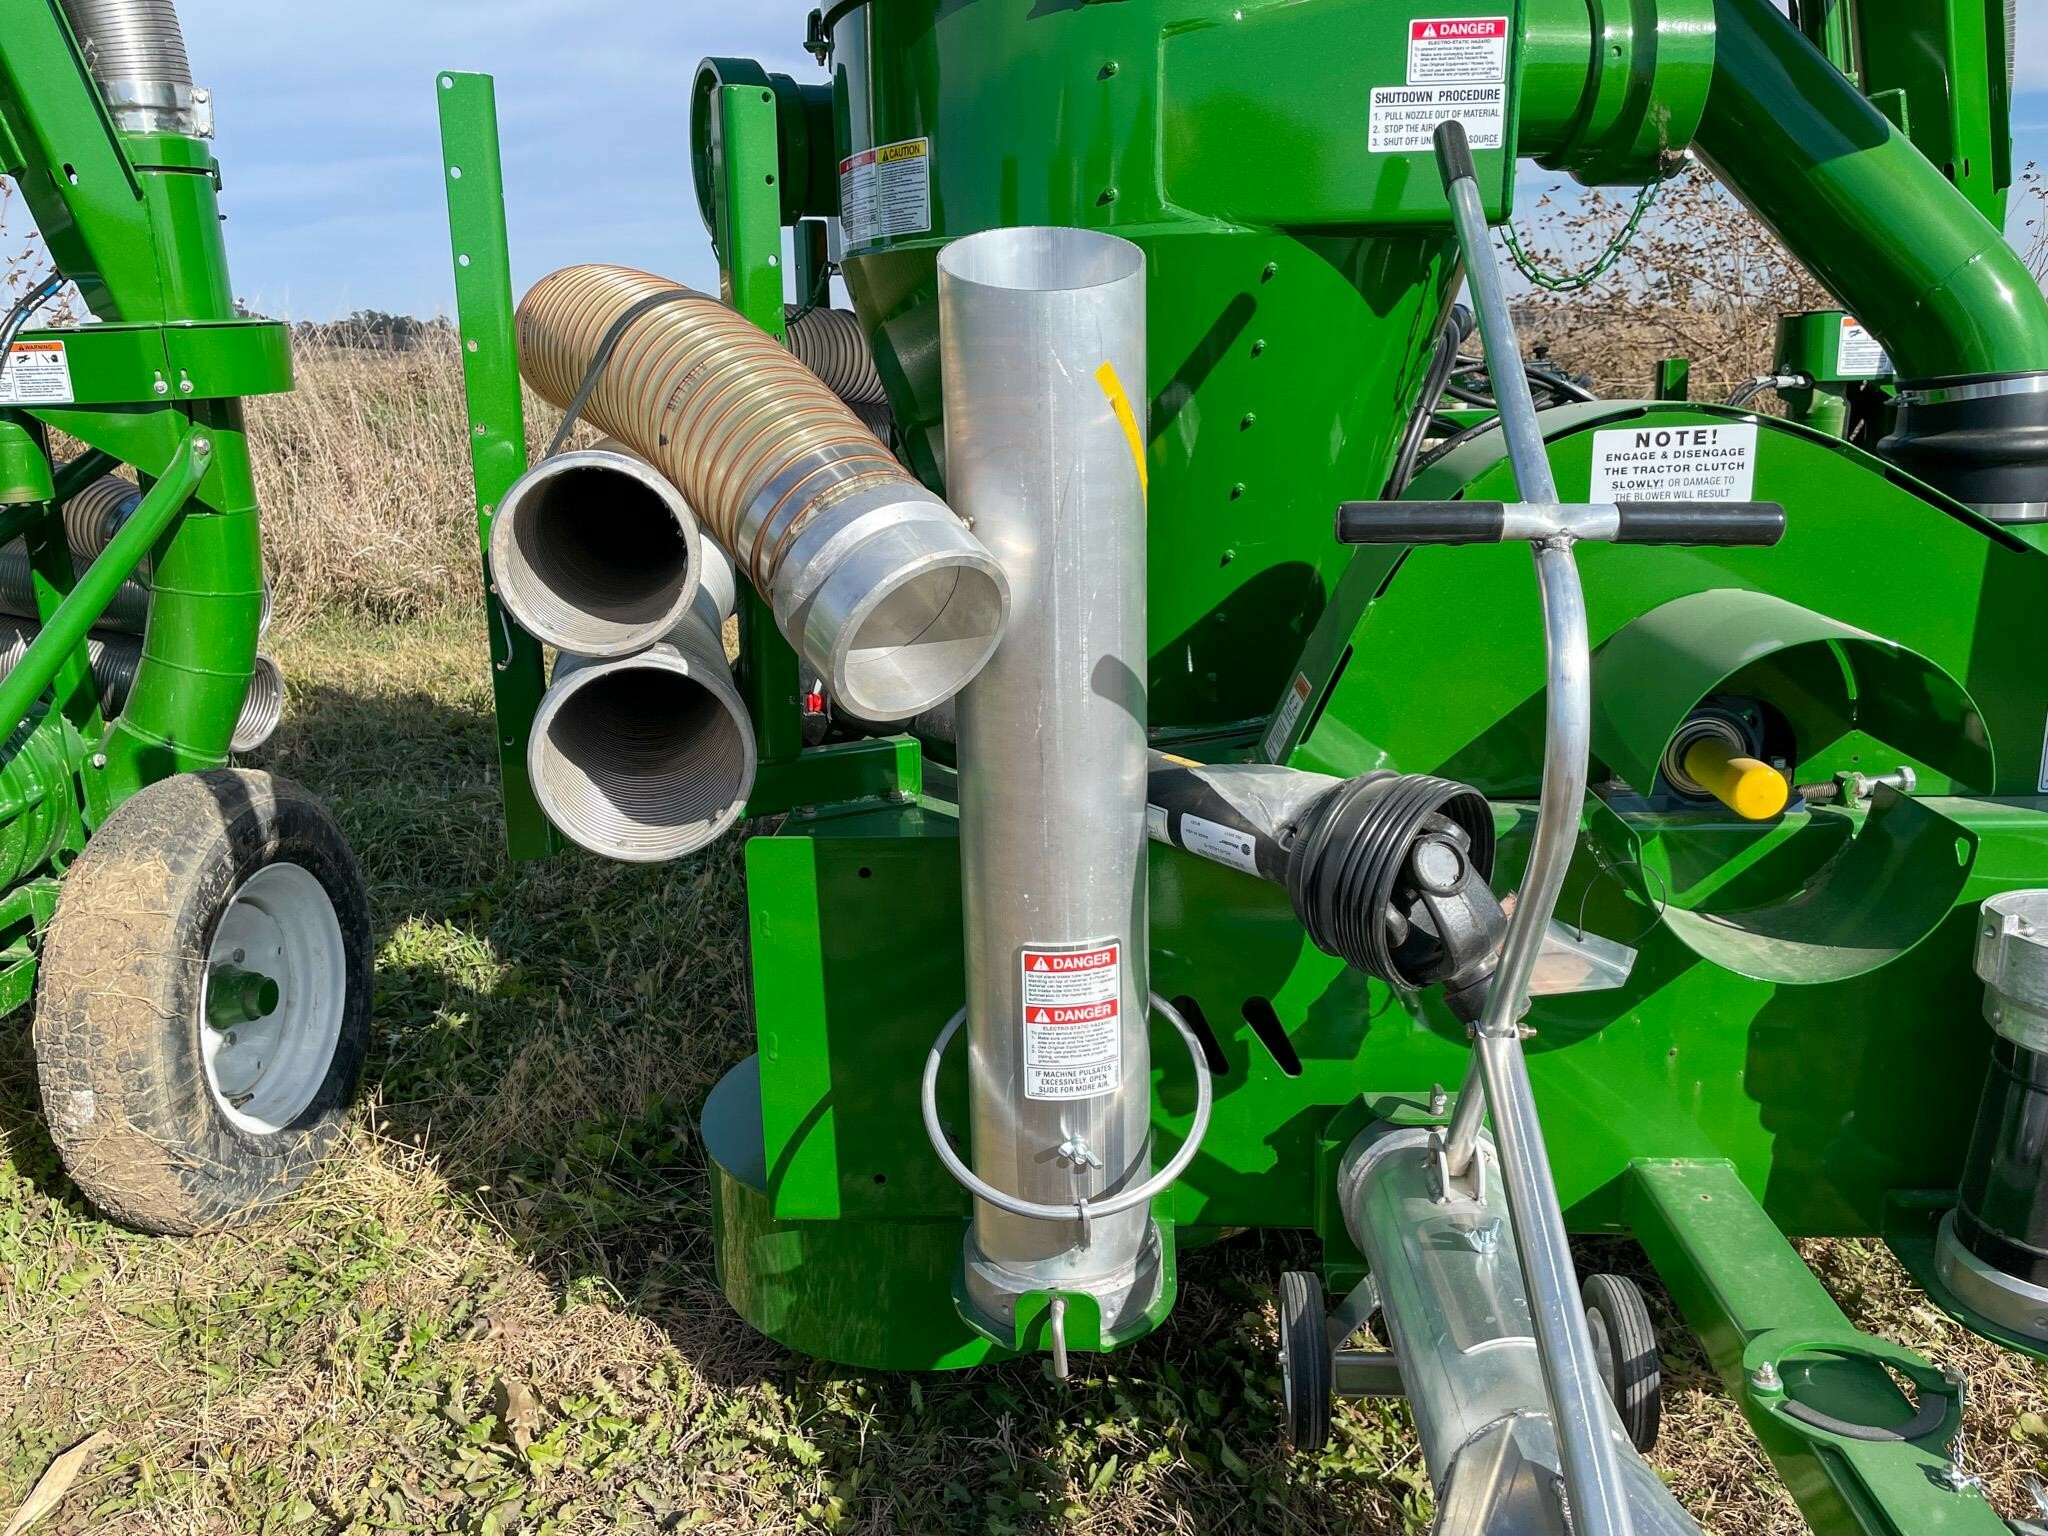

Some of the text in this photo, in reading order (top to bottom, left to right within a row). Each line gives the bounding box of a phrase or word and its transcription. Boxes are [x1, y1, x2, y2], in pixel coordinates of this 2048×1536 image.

[1440, 23, 1496, 35] DANGER
[1375, 89, 1500, 104] SHUTDOWN PROCEDURE
[1385, 112, 1403, 120] PULL
[1405, 111, 1433, 119] NOZZLE
[1435, 110, 1450, 119] OUT
[1452, 110, 1461, 118] OF
[1463, 109, 1500, 117] MATERIAL
[1384, 125, 1403, 133] STOP
[1405, 124, 1418, 132] THE
[1372, 138, 1379, 146] 3.
[1383, 137, 1403, 146] SHUT
[1405, 137, 1418, 145] OFF
[1468, 134, 1498, 143] SOURCE
[889, 145, 920, 158] CAUTION
[1635, 429, 1718, 448] NOTE!
[1606, 448, 1745, 462] ENGAGE & DISENGAGE
[1604, 462, 1745, 476] THE TRACTOR CLUTCH
[1612, 476, 1735, 489] SLOWLY! OR DAMAGE TO
[1614, 489, 1731, 501] THE BLOWER WILL RESULT
[1053, 952, 1111, 970] DANGER
[1054, 1004, 1112, 1022] DANGER
[1079, 1064, 1112, 1076] PULSATES
[1090, 1073, 1107, 1082] OPEN
[1076, 1084, 1095, 1093] MORE
